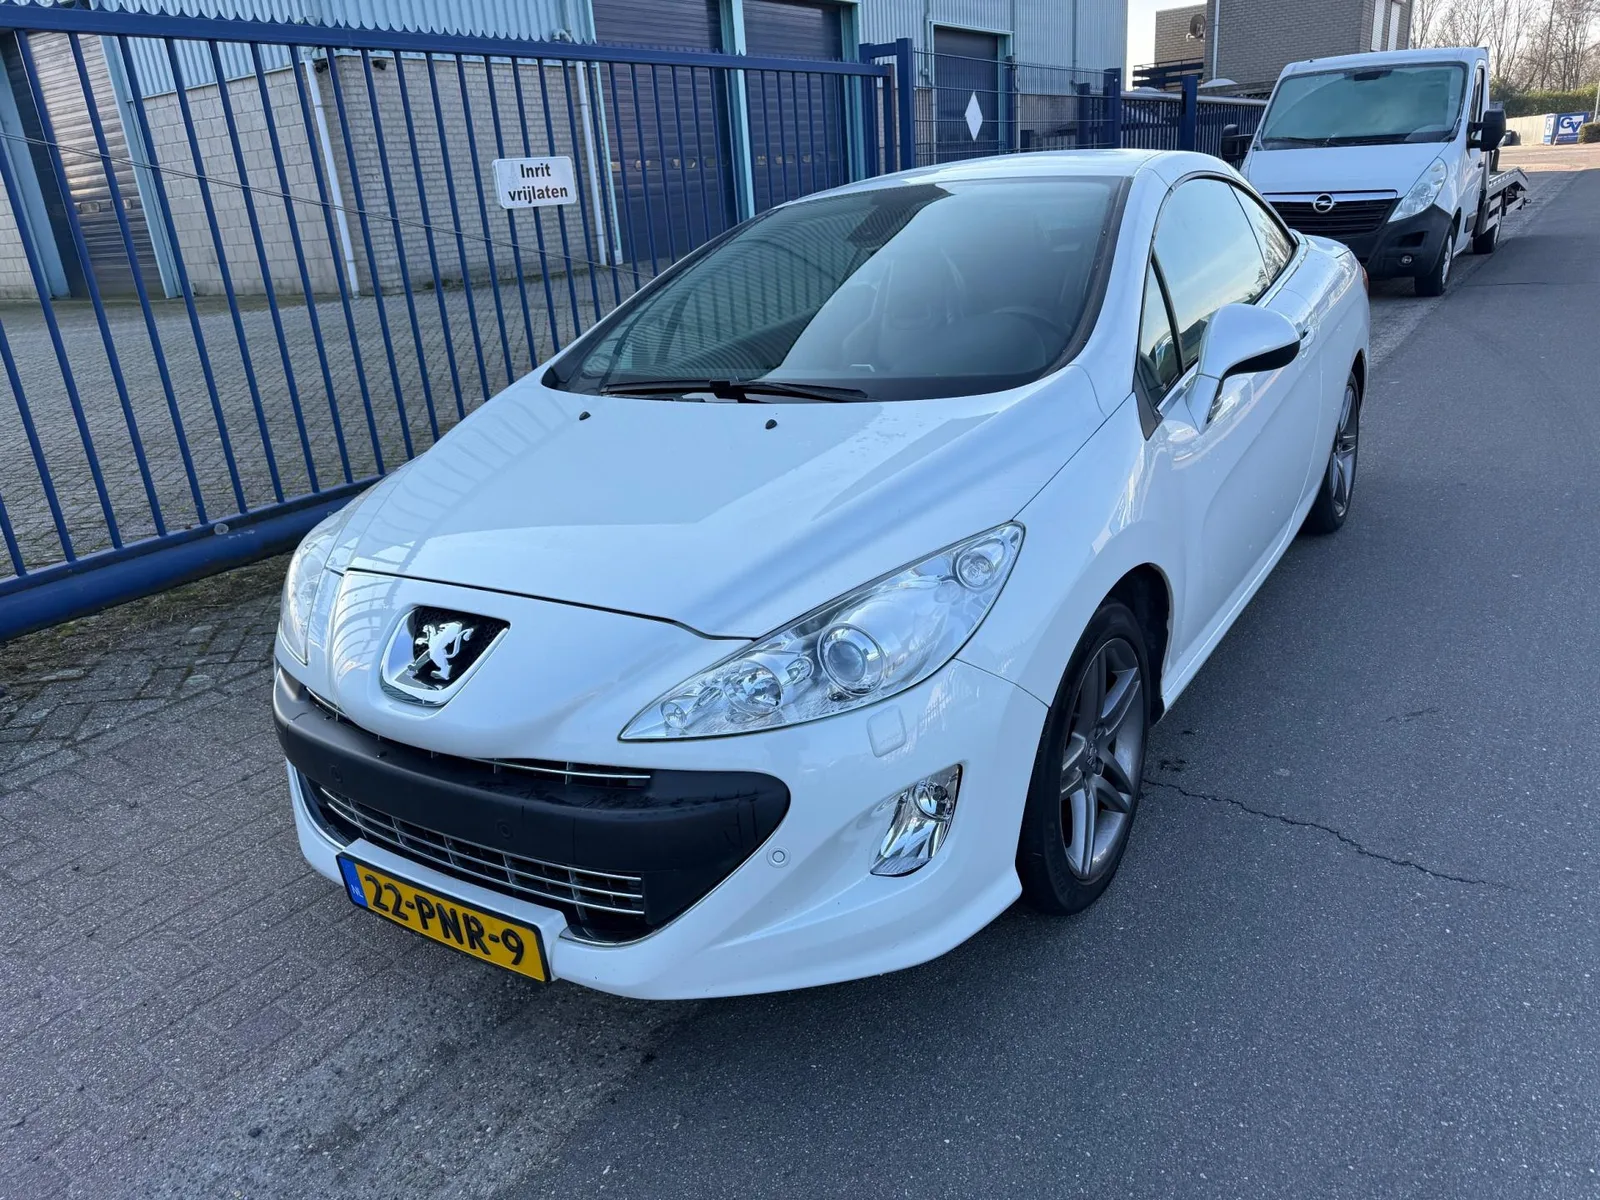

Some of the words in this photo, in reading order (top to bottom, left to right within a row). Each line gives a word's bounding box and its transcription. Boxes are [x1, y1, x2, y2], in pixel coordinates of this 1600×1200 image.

[1560, 117, 1582, 133] GV
[520, 163, 551, 178] Inrit
[508, 185, 568, 204] vrijlaten
[351, 884, 364, 898] NL
[364, 874, 525, 965] 22-PNR-9
